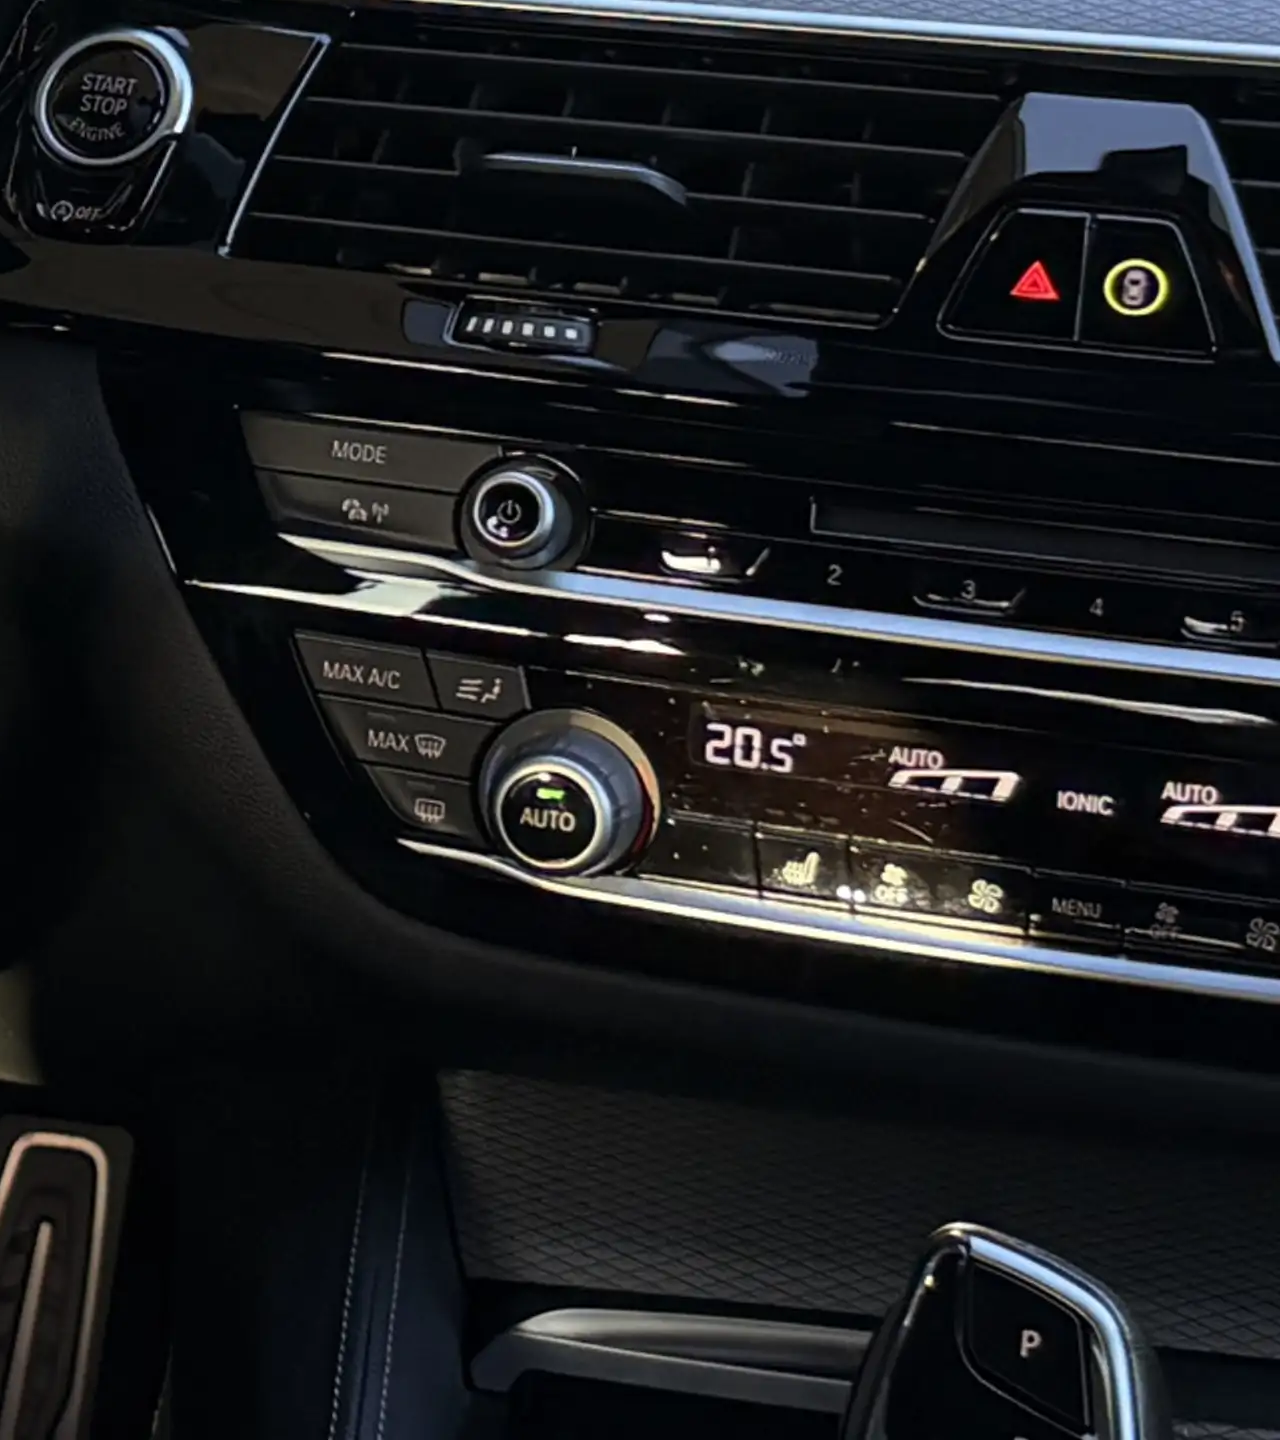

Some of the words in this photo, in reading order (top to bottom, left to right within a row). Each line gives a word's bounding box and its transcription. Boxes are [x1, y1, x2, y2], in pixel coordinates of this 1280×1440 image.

[80, 71, 139, 97] START
[79, 93, 128, 116] STOP
[69, 116, 126, 142] ENGINE
[75, 206, 102, 221] OFF
[331, 439, 388, 465] MODE
[826, 564, 843, 586] 2
[960, 579, 977, 600] 3
[1089, 598, 1104, 617] 4
[322, 660, 364, 686] MAX
[366, 665, 402, 690] A/C
[367, 728, 410, 754] MAX
[888, 745, 943, 770] AUTO
[1056, 789, 1114, 816] IONIC
[1161, 781, 1219, 806] AUTO
[519, 805, 576, 834] AUTO
[1051, 896, 1103, 920] MENU
[1019, 1328, 1041, 1358] P
